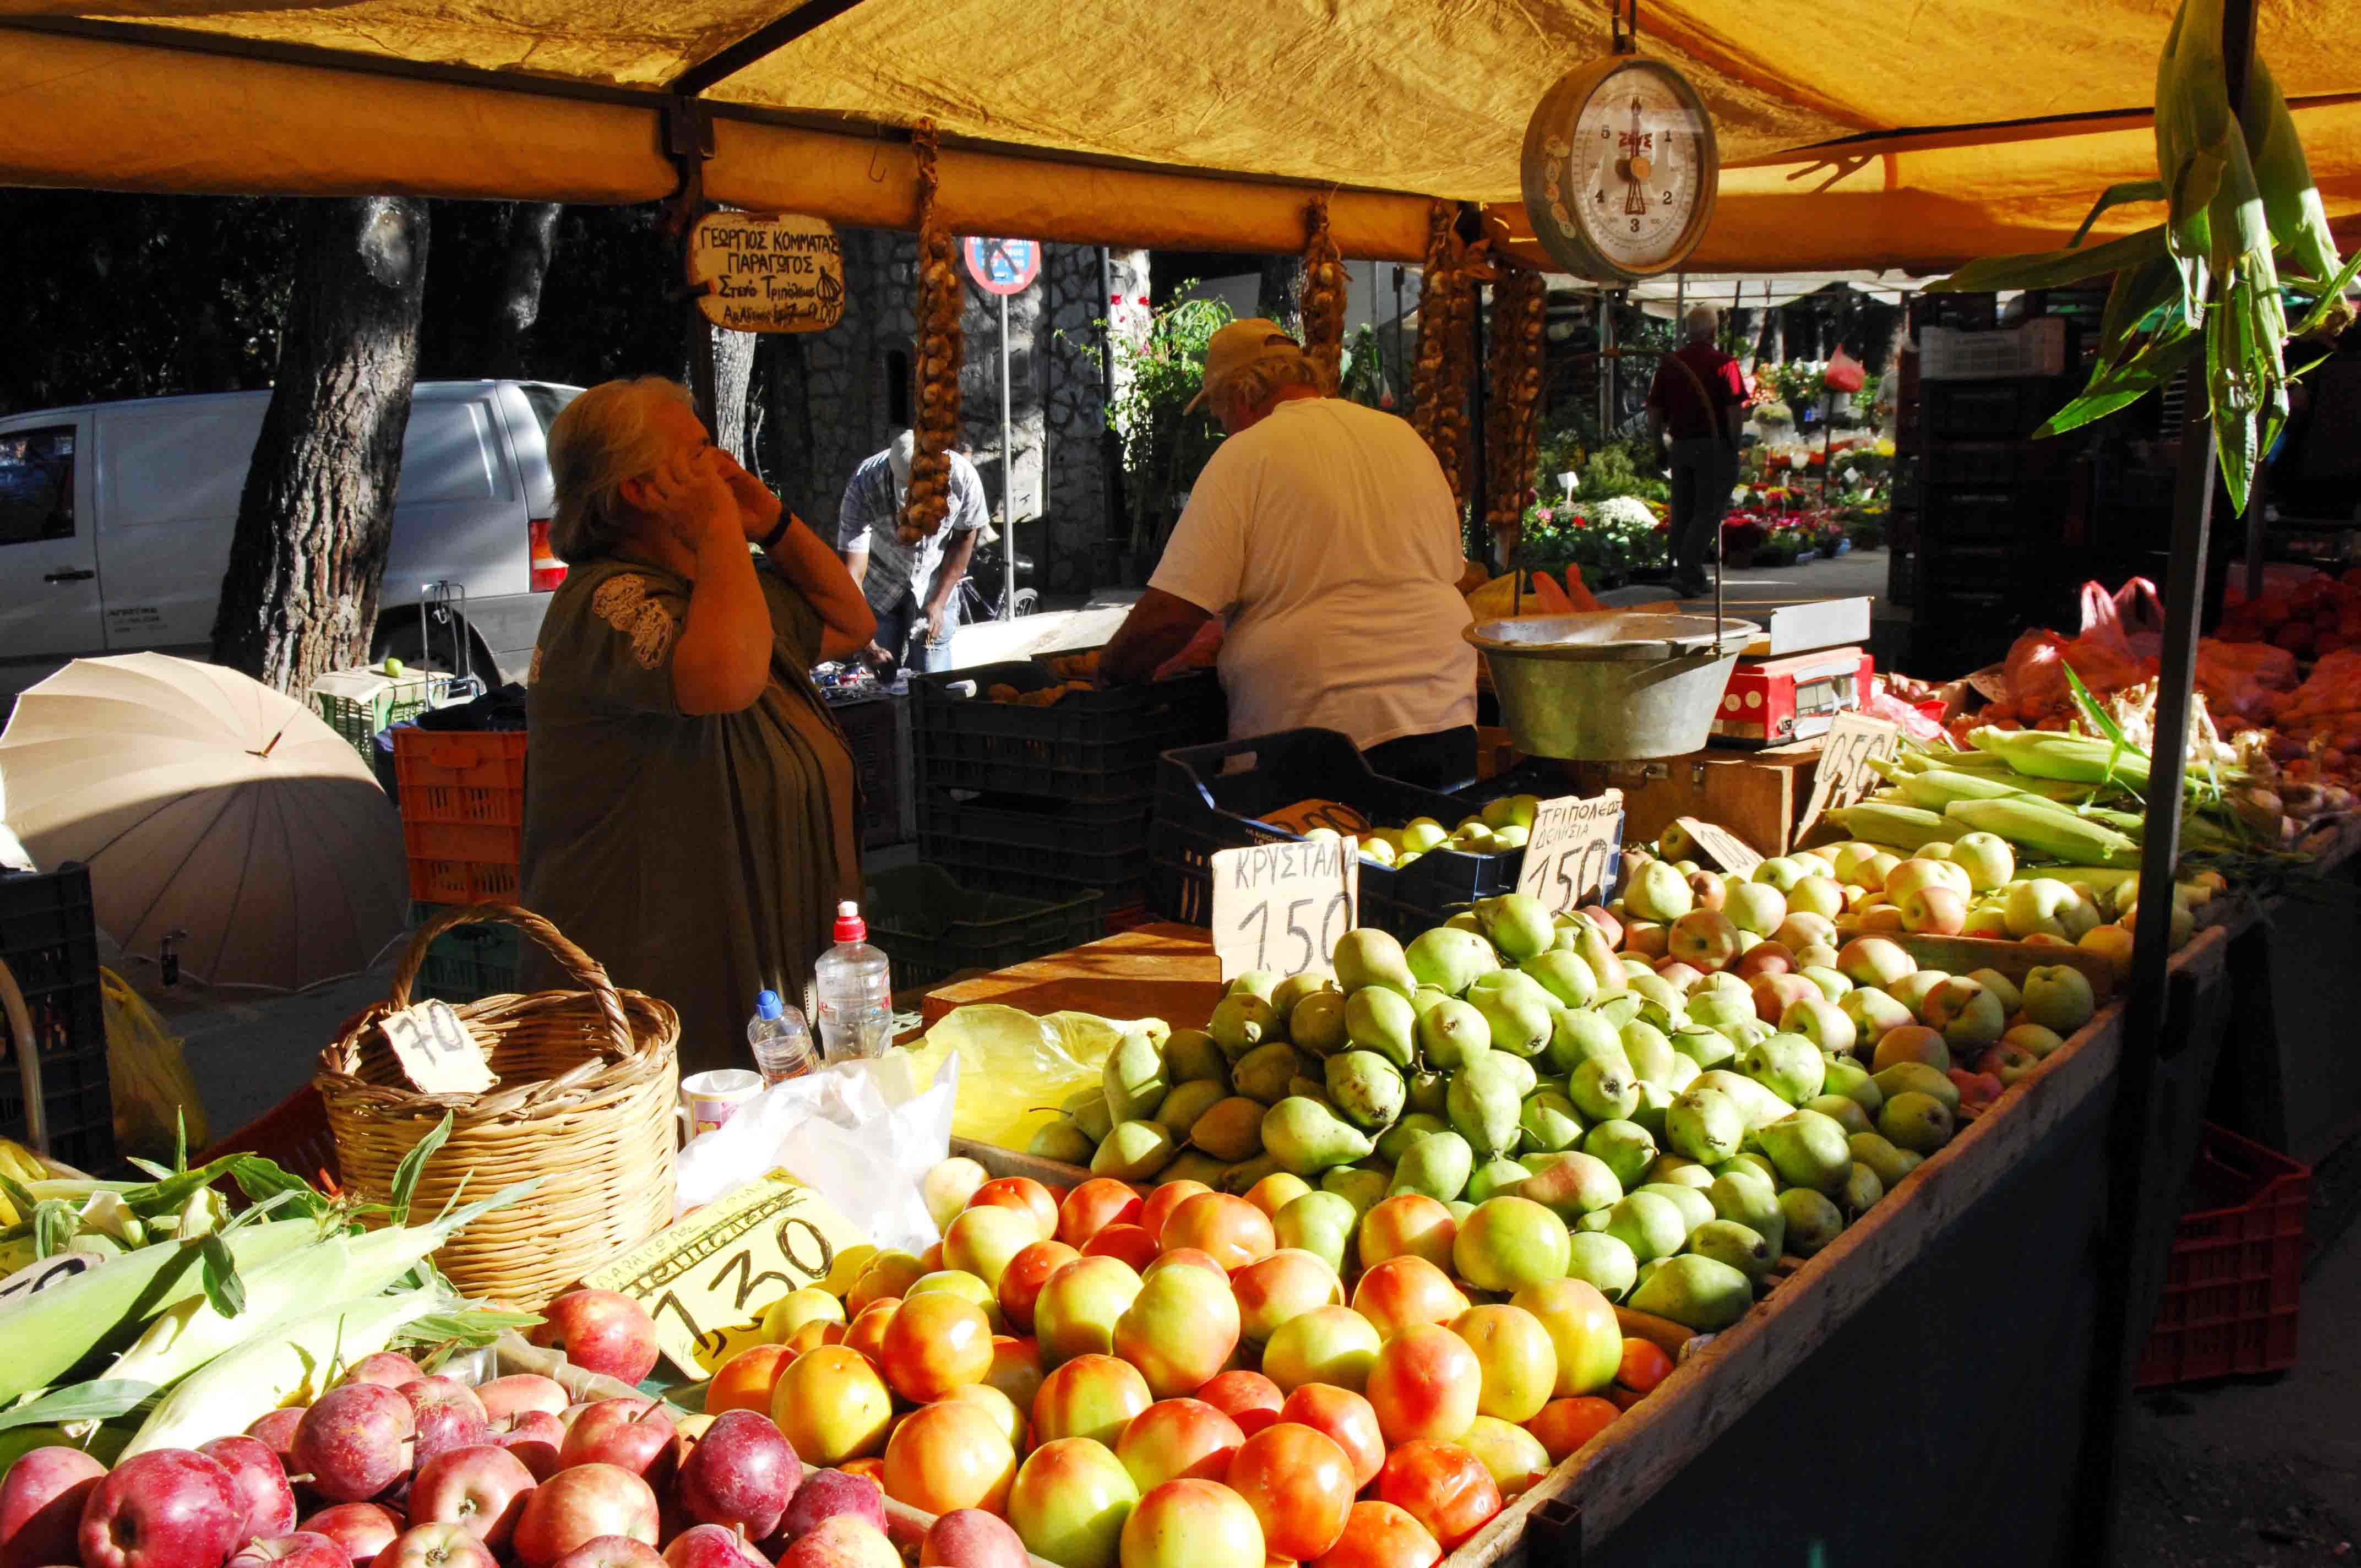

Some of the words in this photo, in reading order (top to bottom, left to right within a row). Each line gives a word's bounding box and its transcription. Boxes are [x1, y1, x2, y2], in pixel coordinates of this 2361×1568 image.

[1601, 125, 1610, 139] 5
[1664, 129, 1672, 143] 1
[1595, 189, 1605, 204] 4
[1663, 190, 1672, 205] 2
[1630, 218, 1640, 233] 3
[700, 226, 768, 251] ΓΕΩΡΓΙΟΣ
[393, 1001, 464, 1068] 70
